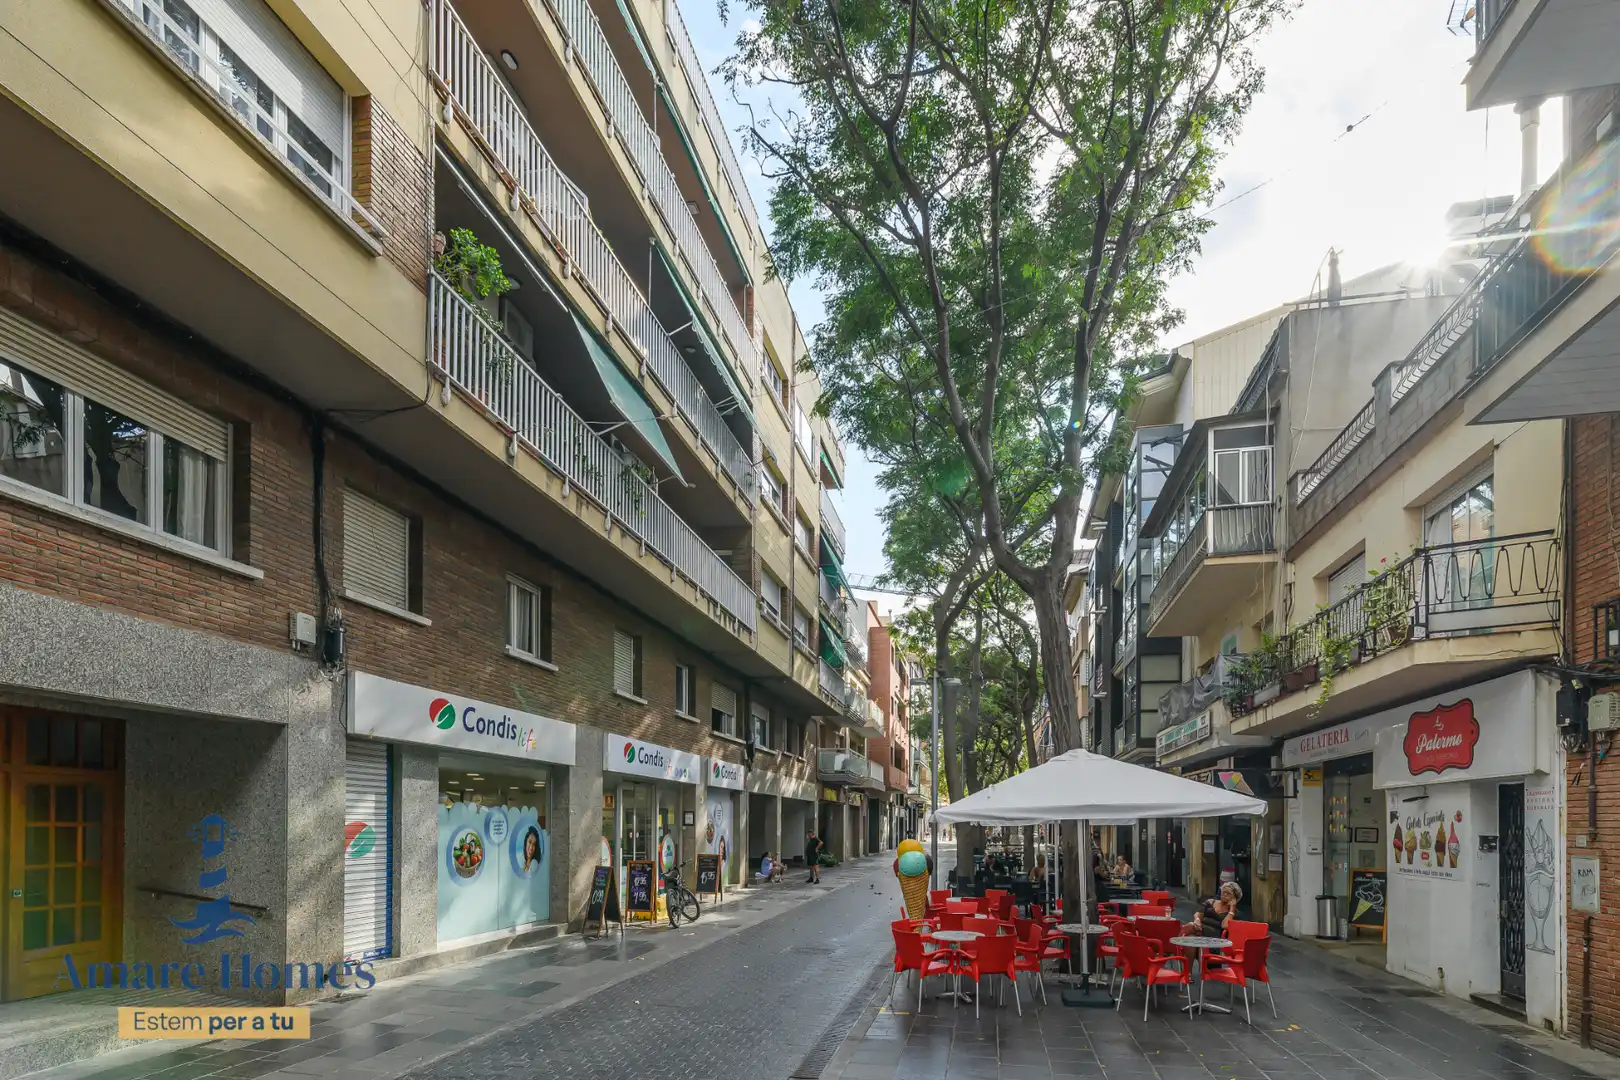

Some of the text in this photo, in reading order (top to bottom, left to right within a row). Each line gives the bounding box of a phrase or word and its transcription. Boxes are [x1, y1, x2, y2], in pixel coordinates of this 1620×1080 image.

[462, 706, 517, 740] Condis
[1300, 727, 1349, 753] GELATERIA
[1415, 732, 1463, 754] Palermo
[638, 747, 664, 768] Condis
